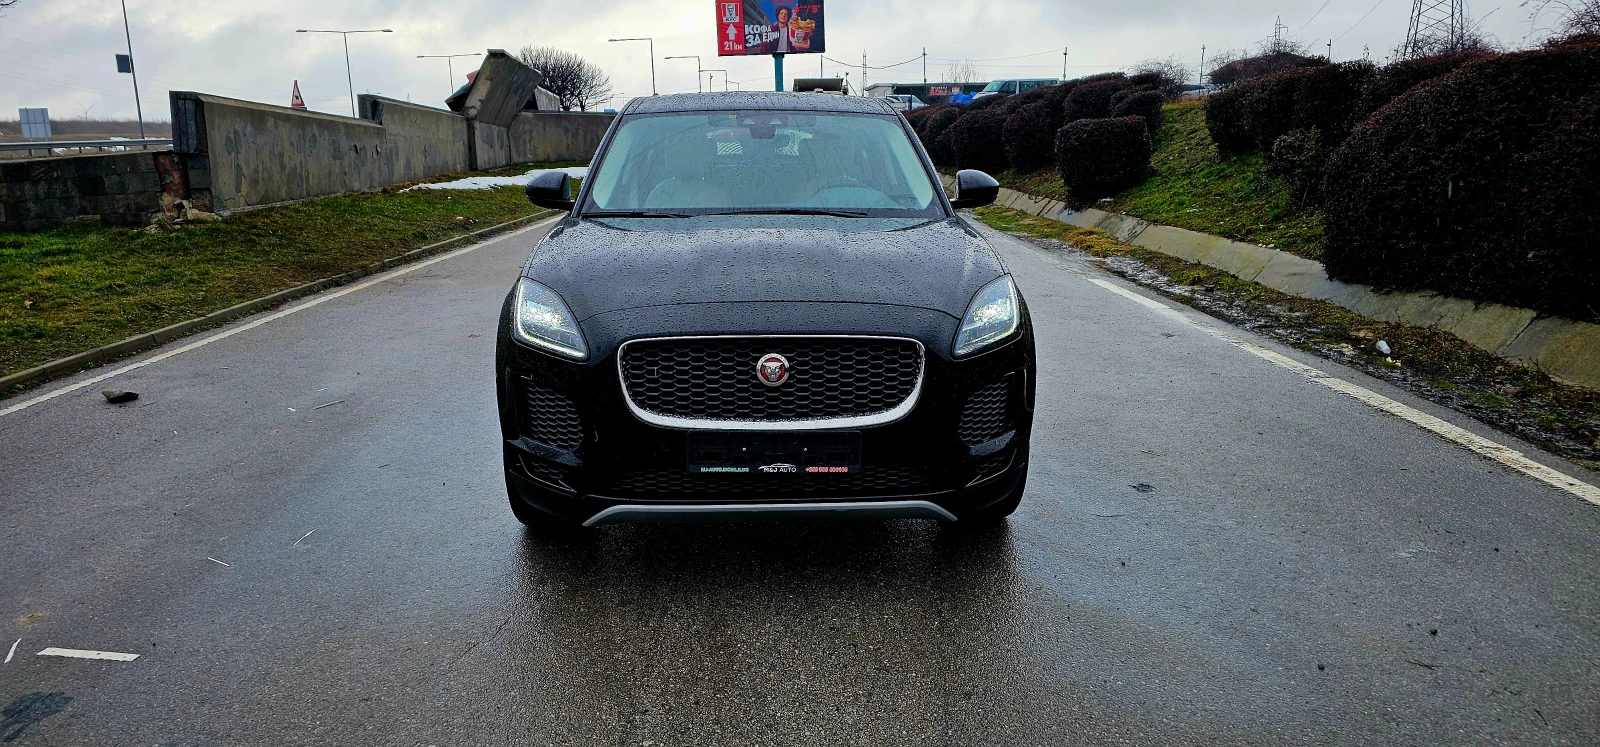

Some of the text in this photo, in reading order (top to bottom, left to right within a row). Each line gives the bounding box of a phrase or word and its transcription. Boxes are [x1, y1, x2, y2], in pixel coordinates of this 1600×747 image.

[744, 24, 772, 35] КОФА
[746, 31, 780, 47] ЗА ЕДИН
[724, 41, 733, 50] 21
